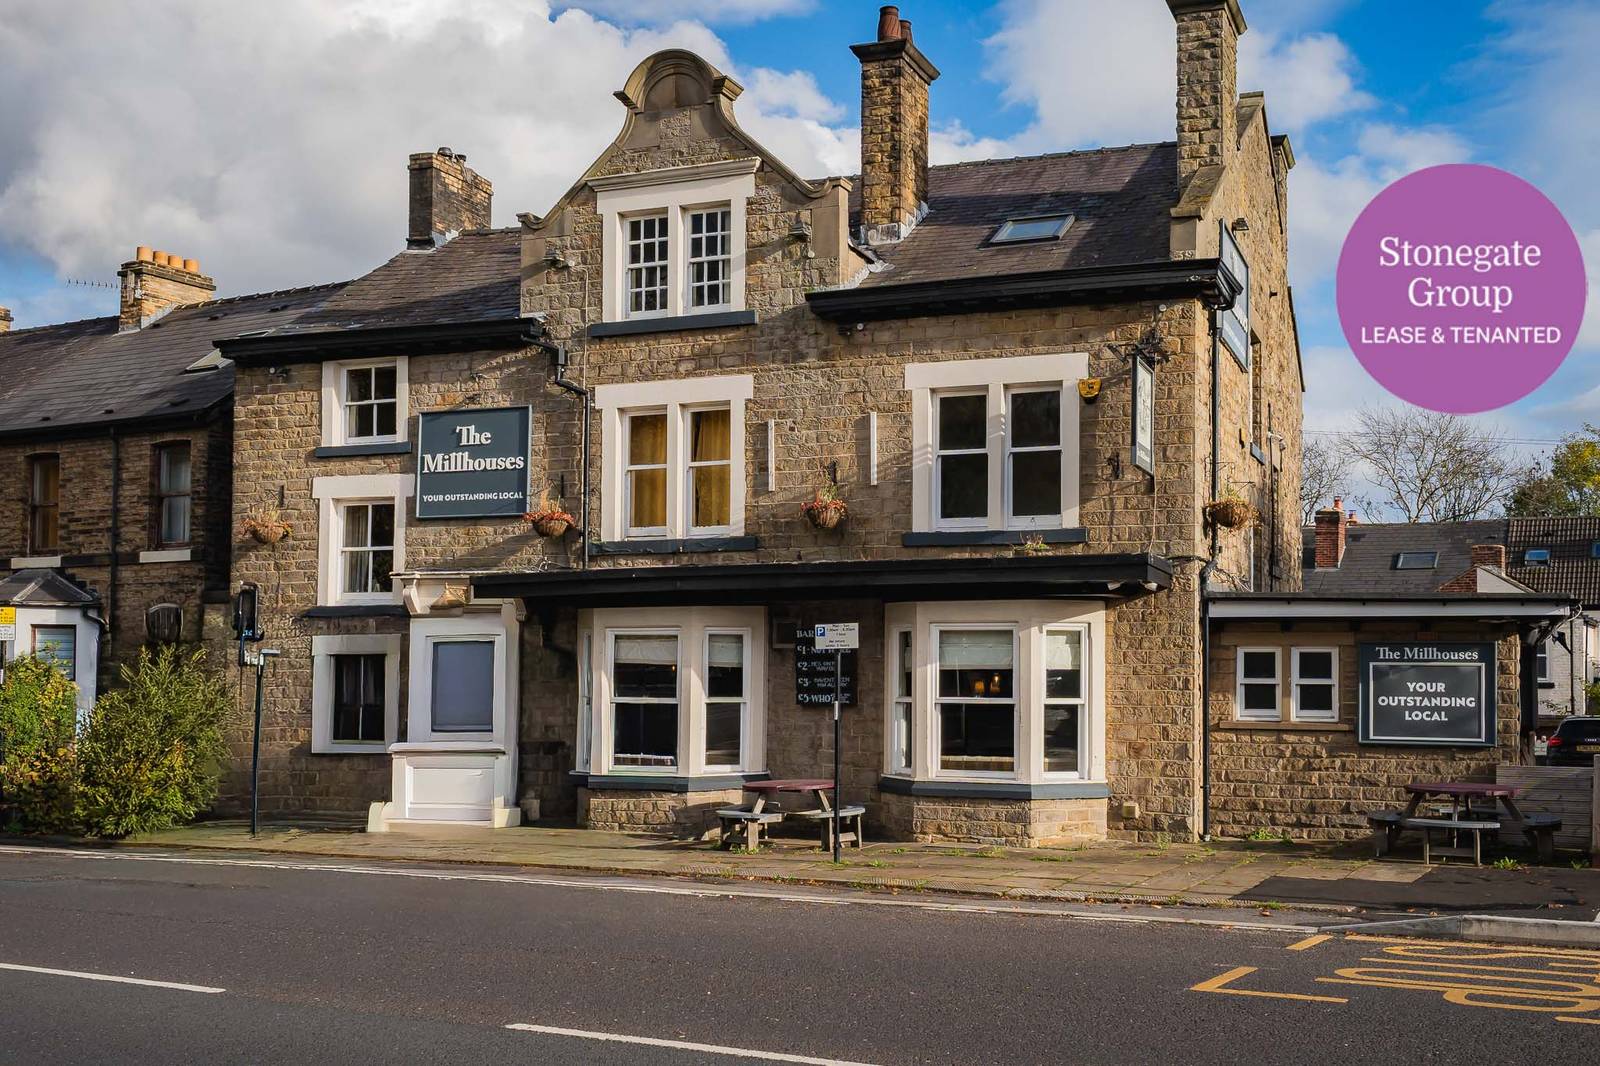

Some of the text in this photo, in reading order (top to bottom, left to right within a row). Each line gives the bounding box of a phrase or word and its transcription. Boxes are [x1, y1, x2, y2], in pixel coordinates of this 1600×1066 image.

[456, 424, 492, 446] The
[422, 451, 525, 473] Millhouses
[422, 491, 523, 502] YOUR OUTSTANDING LOCAL
[817, 627, 824, 636] P
[1375, 646, 1479, 660] The Millhouses
[1406, 682, 1446, 693] YOUR
[1377, 696, 1476, 707] OUTSTANDING
[1404, 711, 1448, 721] LOCAL
